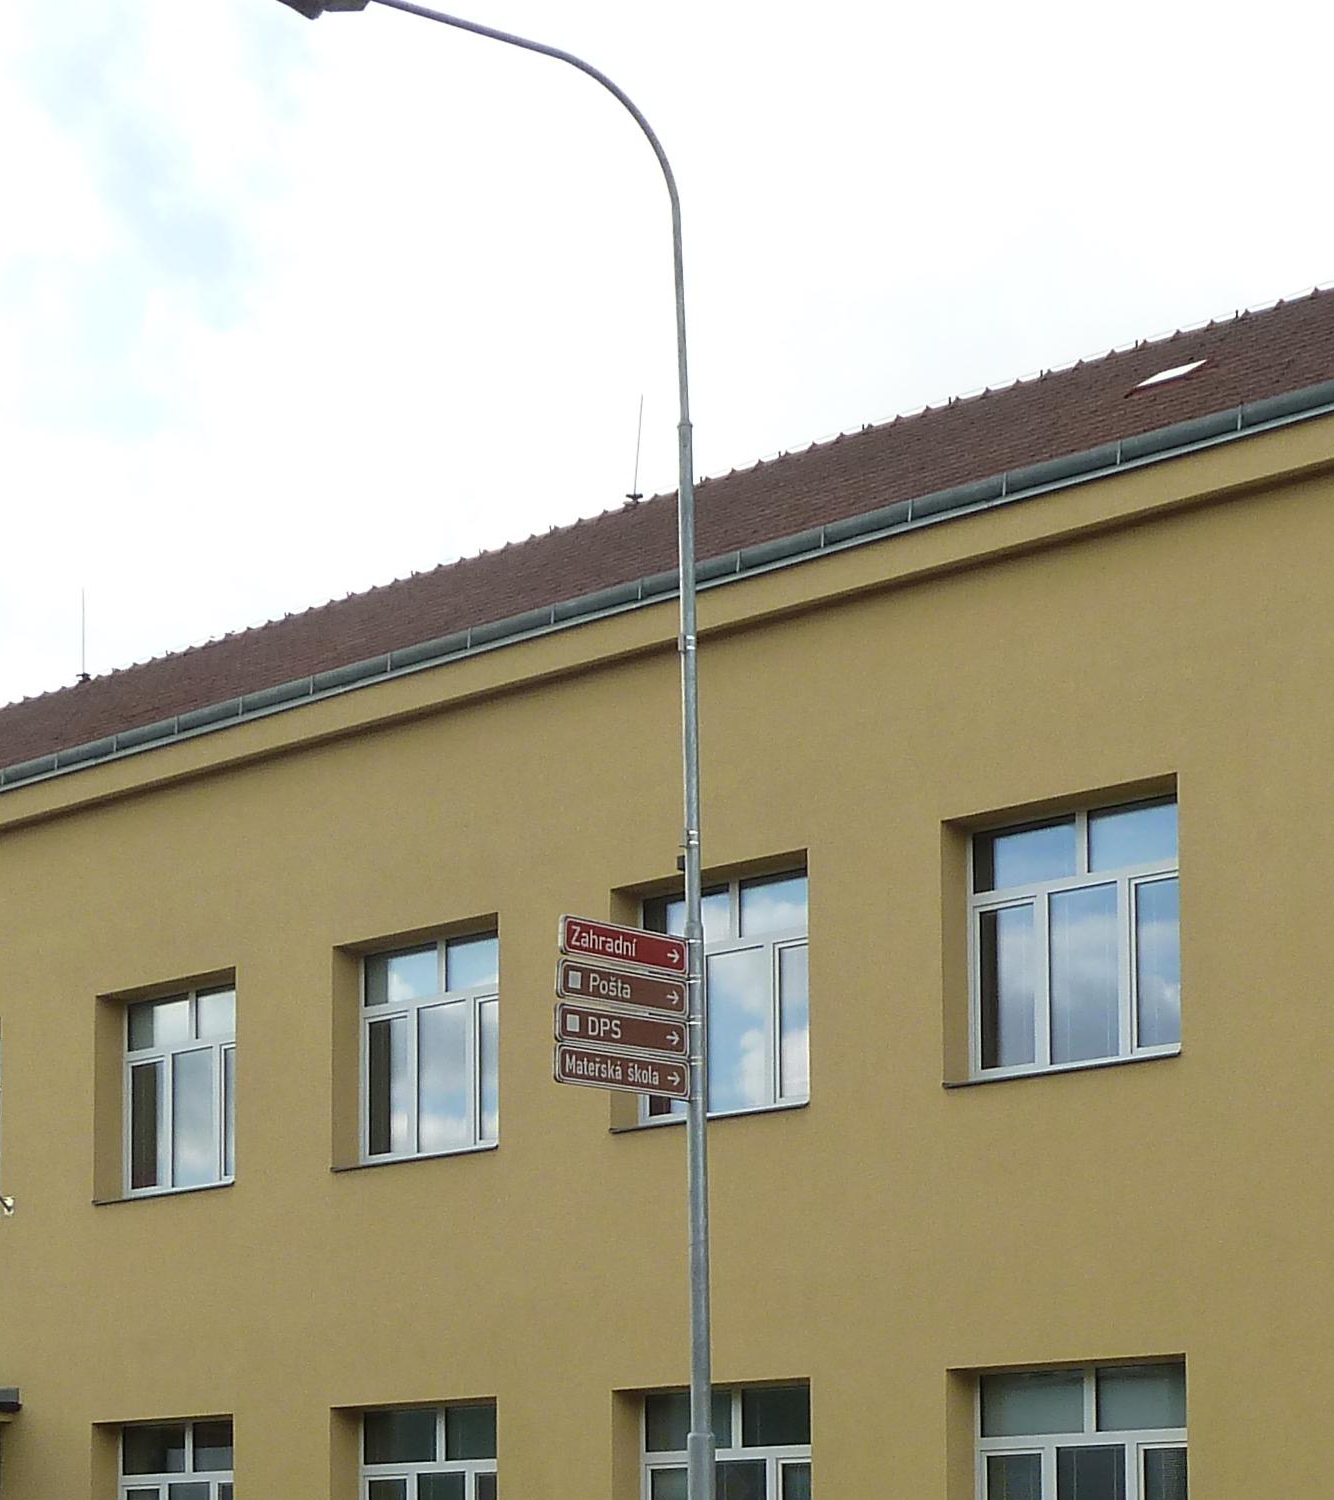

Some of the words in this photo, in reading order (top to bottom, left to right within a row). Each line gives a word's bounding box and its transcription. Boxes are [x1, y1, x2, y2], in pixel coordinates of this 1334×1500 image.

[570, 925, 637, 957] Zahradní
[589, 972, 631, 999] Pošta
[587, 1016, 622, 1039] DPS
[565, 1053, 622, 1081] Mateřská
[627, 1063, 660, 1086] škola
